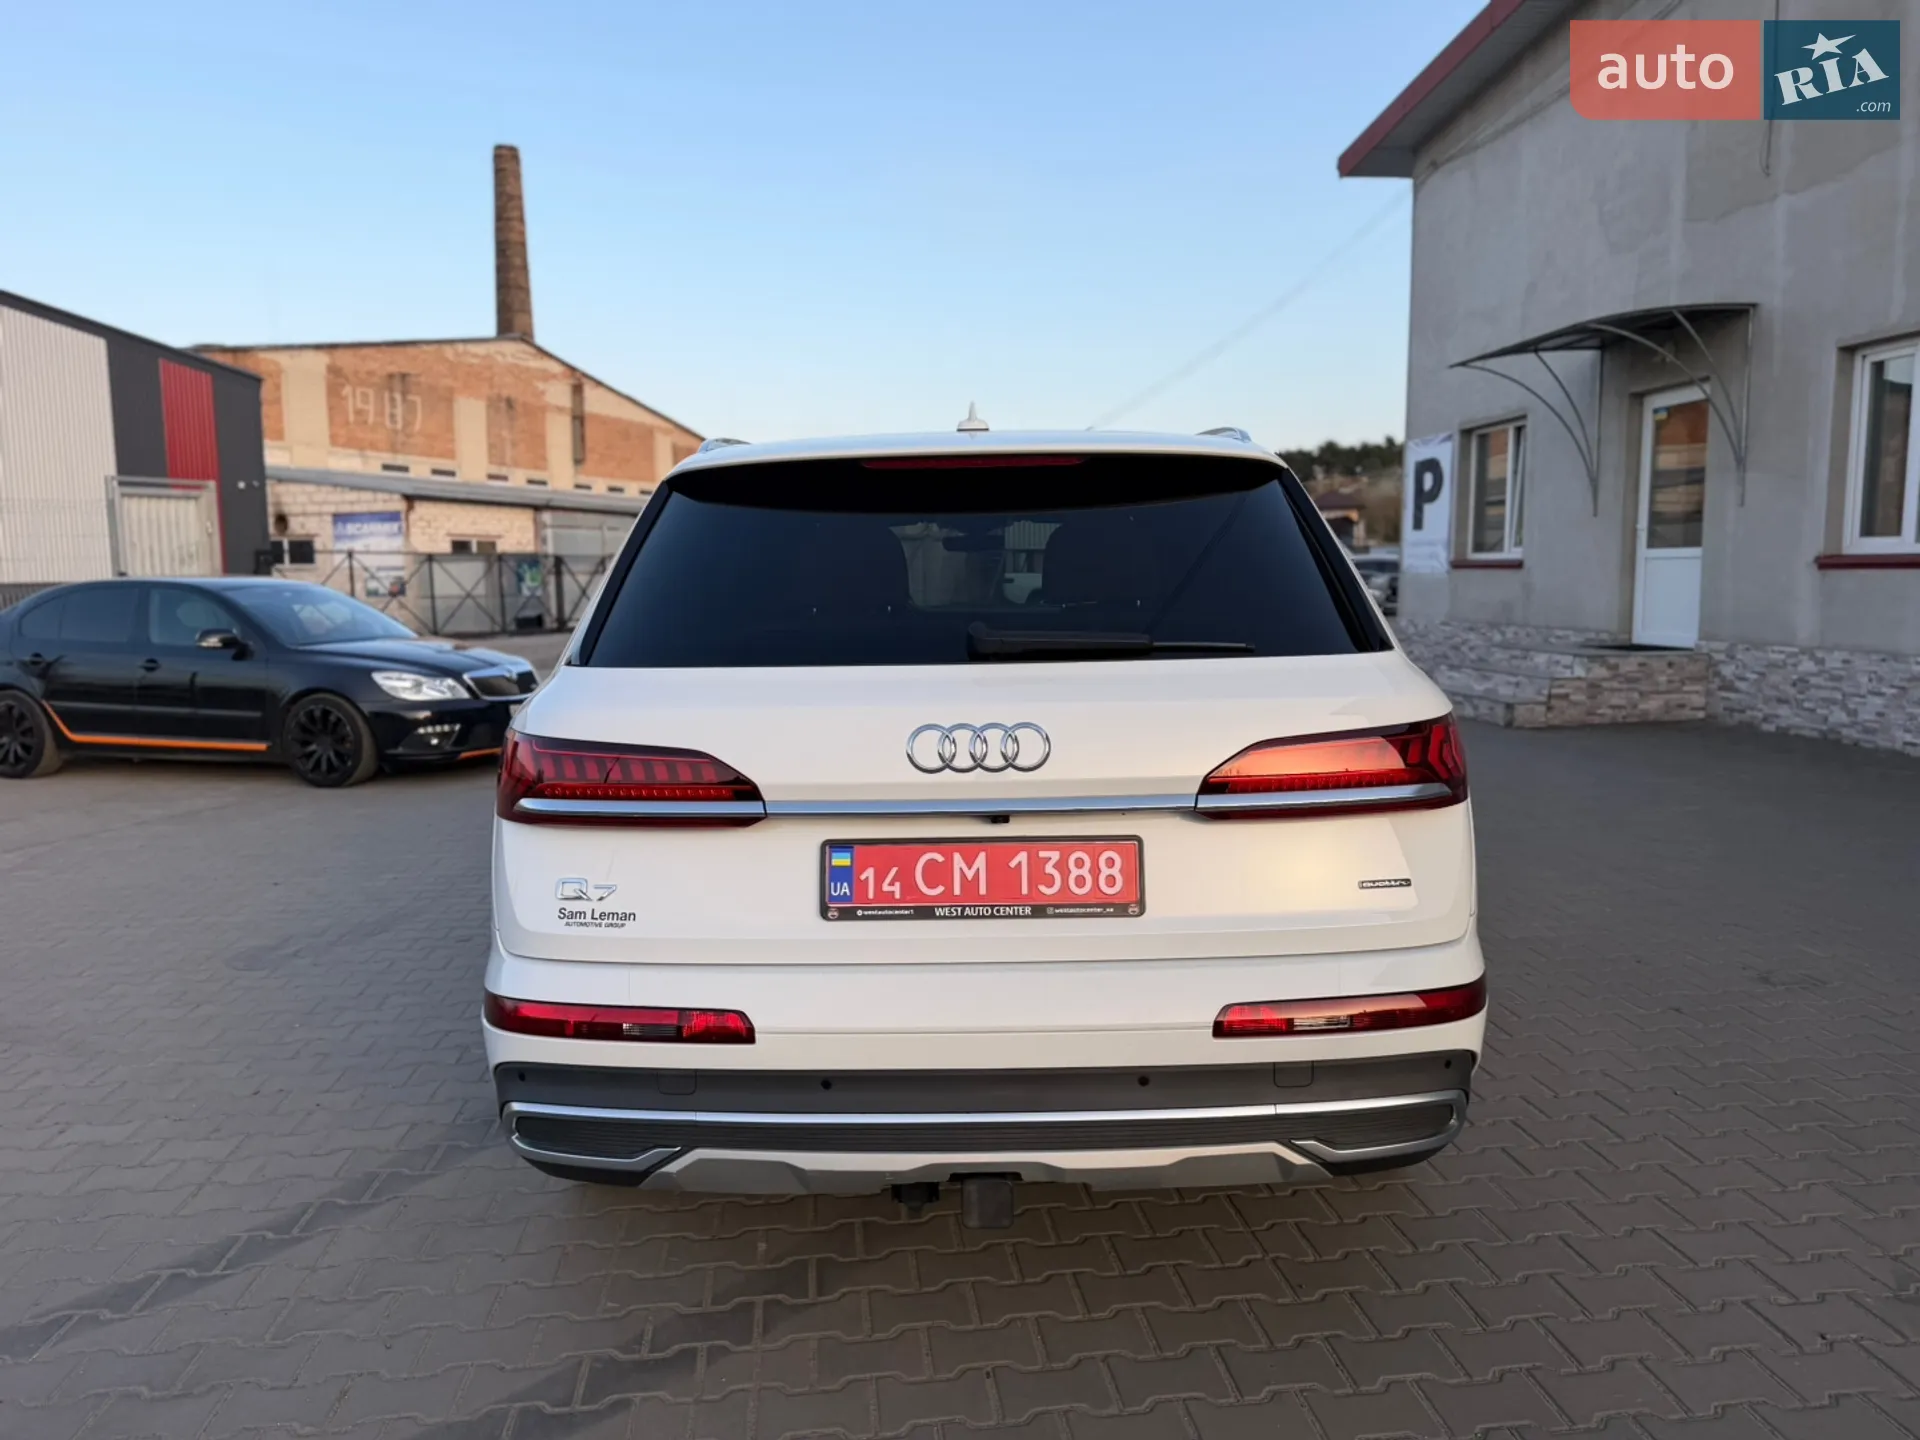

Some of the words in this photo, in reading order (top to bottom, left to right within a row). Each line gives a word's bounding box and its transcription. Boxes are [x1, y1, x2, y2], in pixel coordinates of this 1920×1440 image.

[1412, 457, 1444, 531] P
[859, 866, 901, 899] 14
[914, 851, 987, 896] CM
[1008, 850, 1123, 896] 1388
[555, 877, 617, 902] Q7
[830, 881, 850, 896] UA
[557, 907, 587, 920] Sam
[590, 908, 636, 921] Leman
[934, 907, 963, 916] WEST
[964, 906, 992, 916] AUTO
[993, 906, 1032, 916] CENTER
